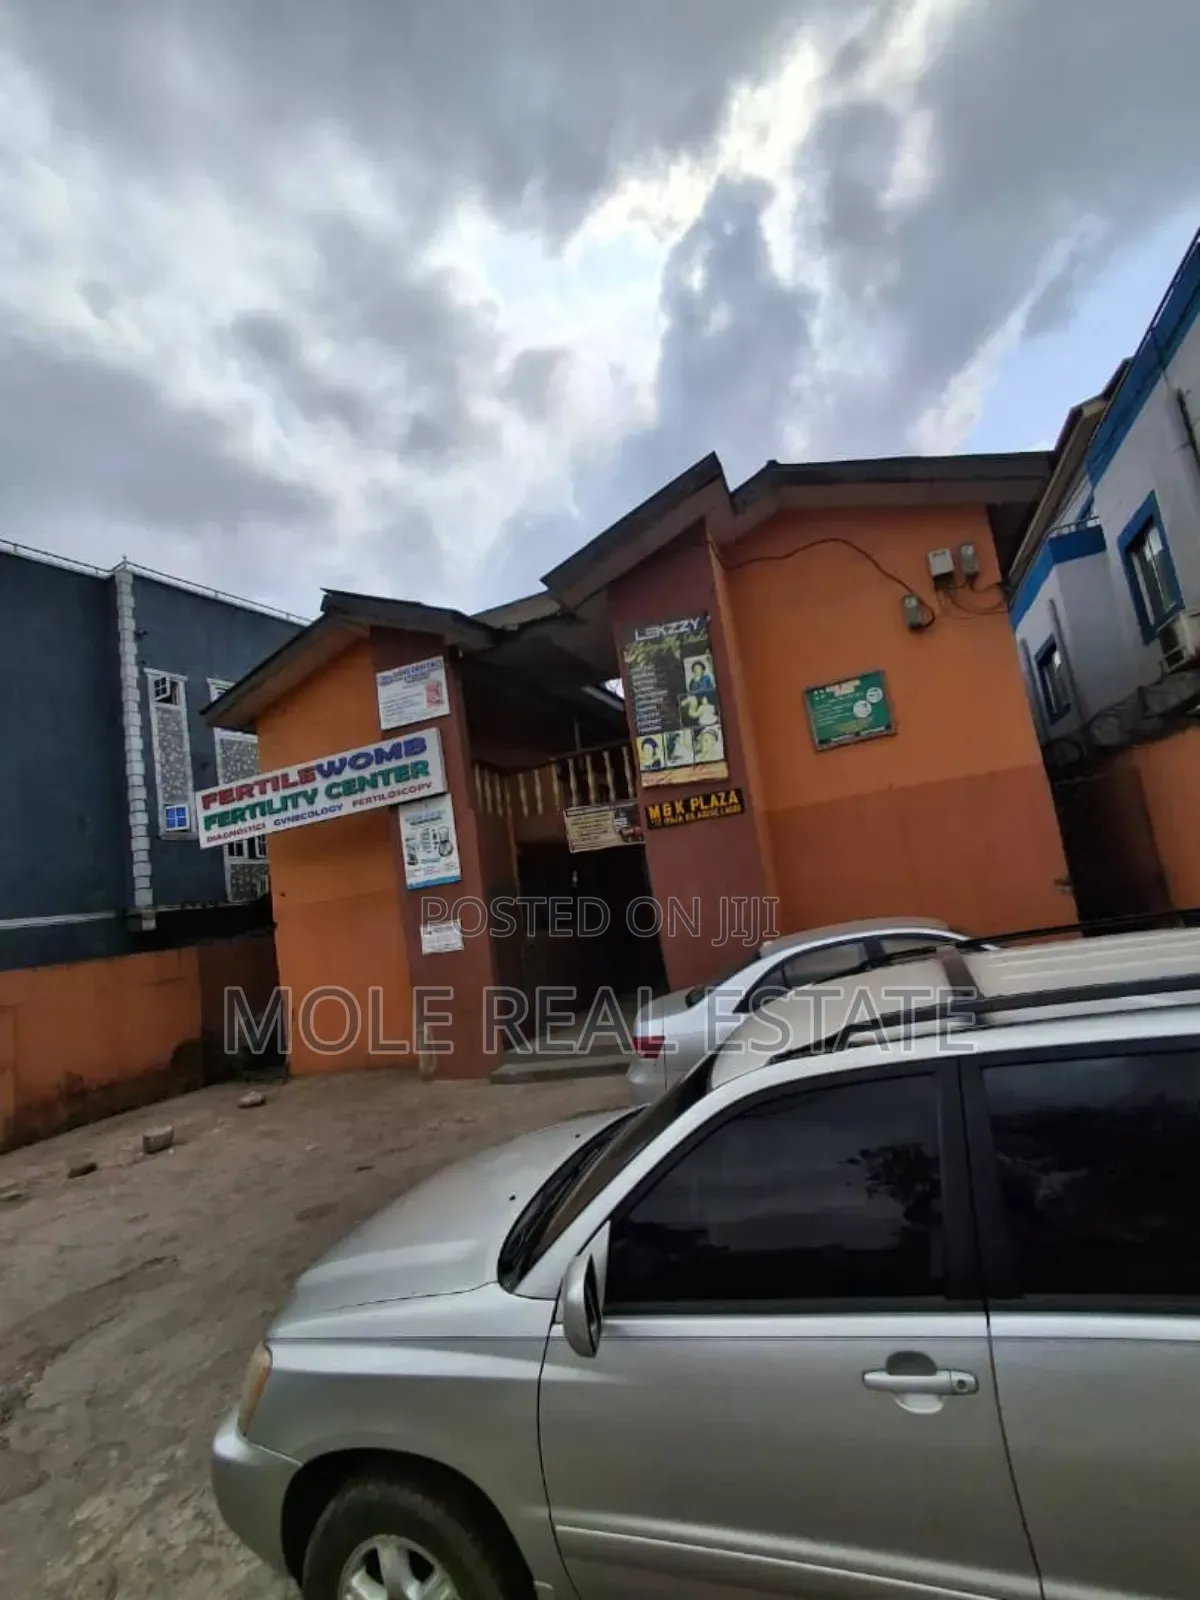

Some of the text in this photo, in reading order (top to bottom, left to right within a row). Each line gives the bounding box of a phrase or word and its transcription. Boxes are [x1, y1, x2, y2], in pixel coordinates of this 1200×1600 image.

[201, 736, 428, 810] FERTILEWOMB
[203, 759, 431, 832] FERTILITY CENTER
[690, 790, 739, 812] PLAZA
[273, 803, 344, 826] GYNECOLOGY
[352, 782, 433, 807] FERTILOSCOPY
